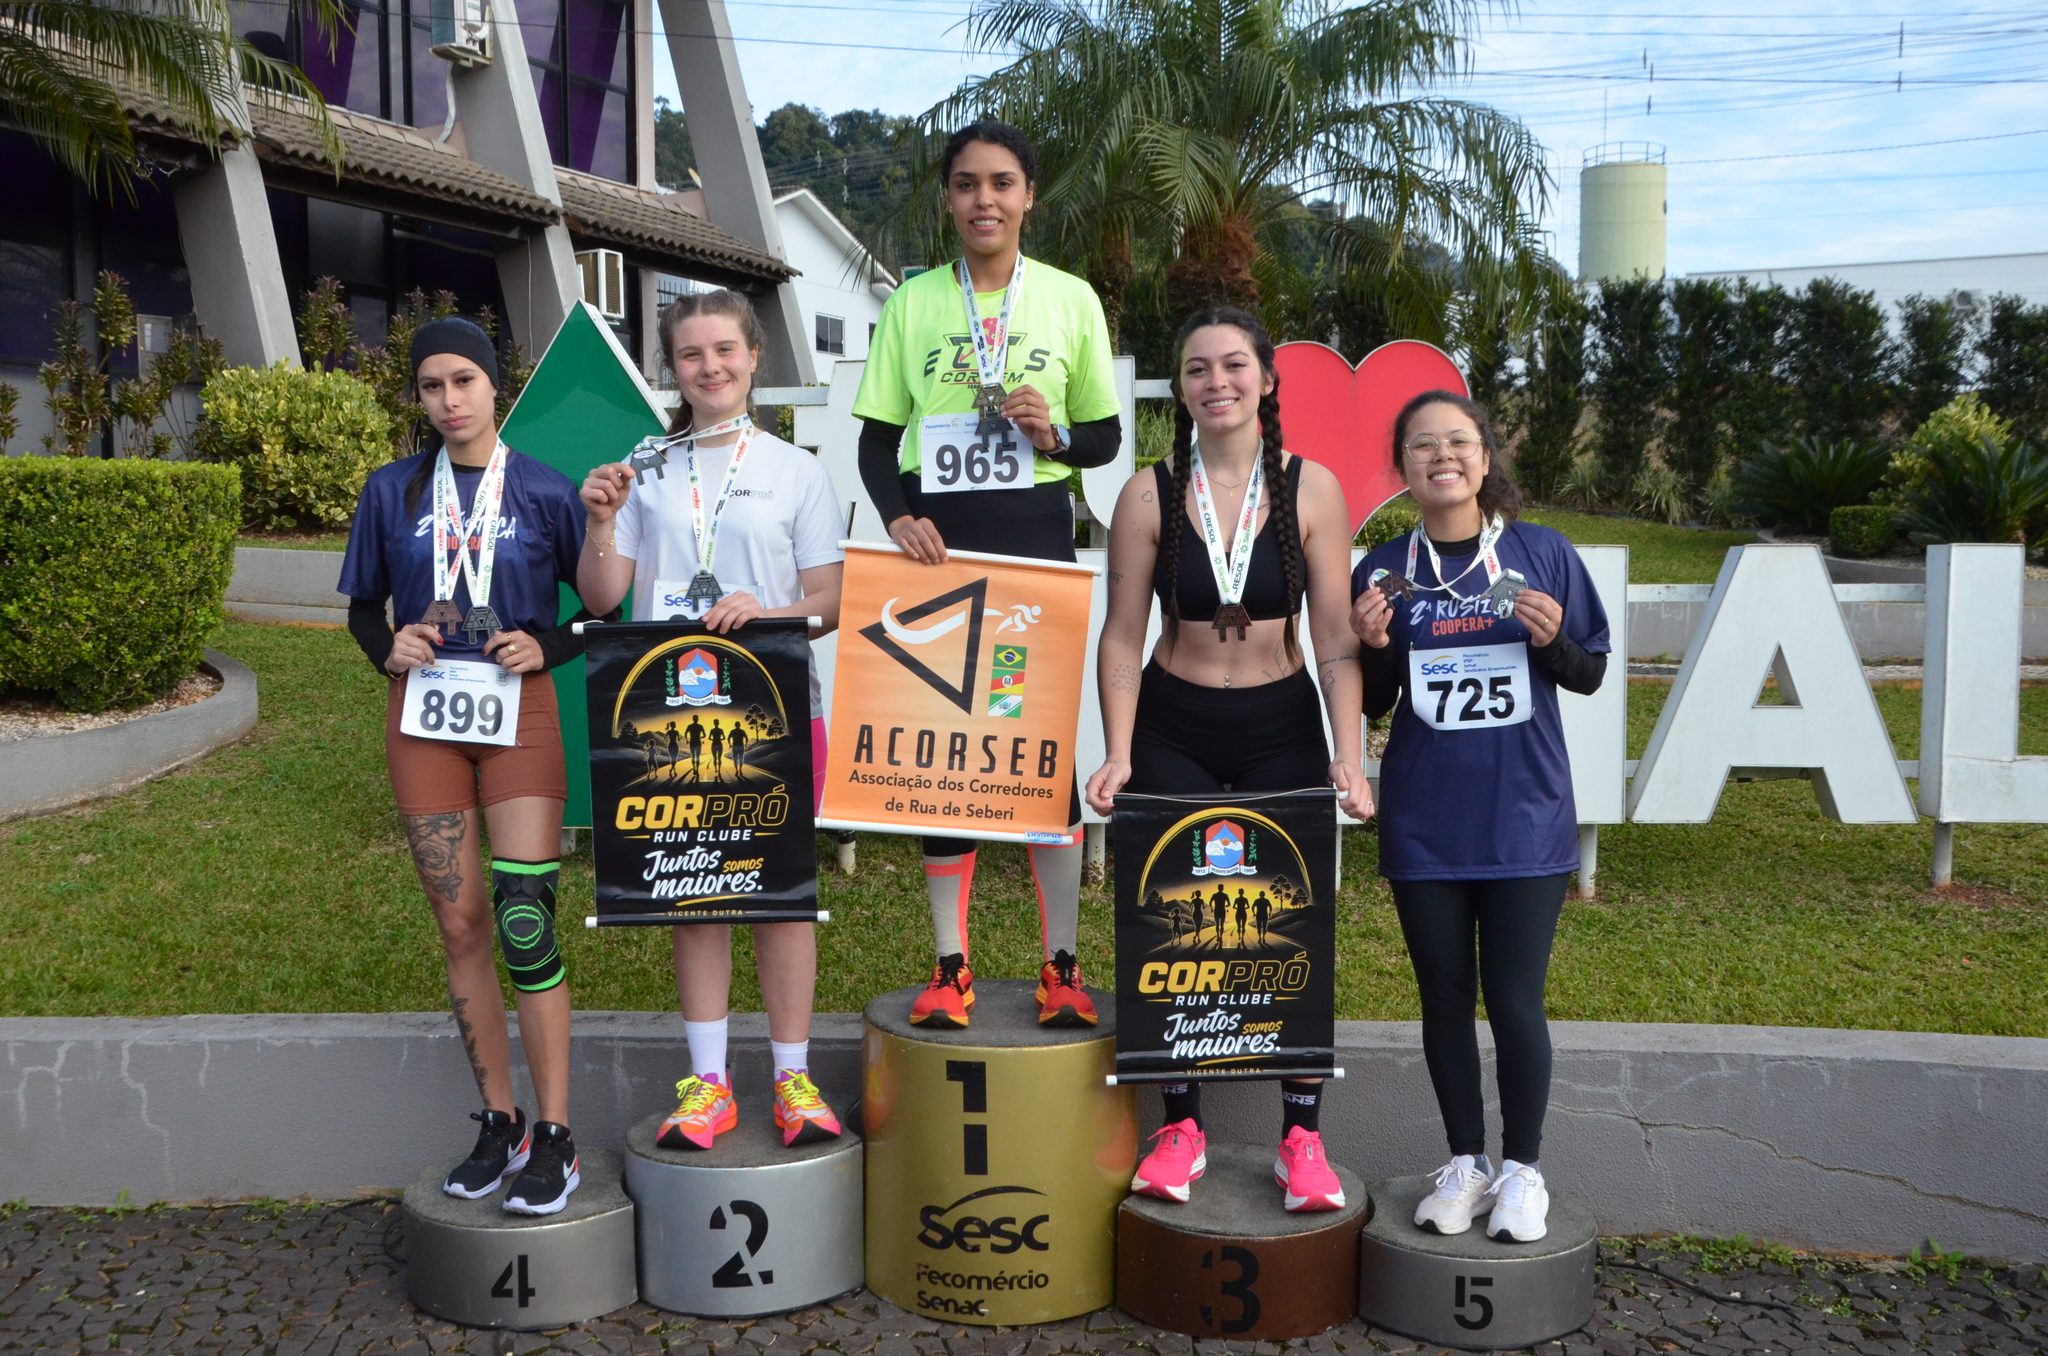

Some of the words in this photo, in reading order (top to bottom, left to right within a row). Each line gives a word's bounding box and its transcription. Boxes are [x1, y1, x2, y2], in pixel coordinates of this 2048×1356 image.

[936, 442, 1019, 485] 965
[664, 594, 693, 607] Ses
[1432, 616, 1494, 636] COOPERA+
[1421, 663, 1458, 675] Sesc
[420, 689, 503, 736] 899
[1427, 676, 1515, 723] 725
[854, 724, 1058, 778] ACORSEB
[849, 769, 932, 792] Associação
[937, 776, 964, 791] dos
[970, 779, 1053, 799] Corredores
[615, 784, 790, 830] CORPRÓ
[885, 797, 904, 812] de
[909, 799, 937, 815] Rua
[942, 801, 960, 816] de
[966, 804, 1014, 820] Seberi
[653, 831, 688, 843] RUN
[697, 829, 752, 842] CLUBE
[643, 845, 722, 881] Juntos
[723, 857, 764, 873] somos
[651, 871, 763, 899] maiores.
[712, 909, 743, 917] DUTRA
[1138, 951, 1310, 994] CORPRÓ
[1175, 995, 1209, 1006] RUN
[1218, 993, 1272, 1005] CLUBE
[1163, 1008, 1241, 1041] Juntos
[1242, 1020, 1283, 1035] somos
[1171, 1032, 1281, 1059] maiores.
[1187, 1068, 1226, 1076] VICENTE
[1231, 1067, 1261, 1075] DUTRA
[946, 1060, 988, 1175] 1
[709, 1200, 774, 1288] 2
[917, 1204, 1049, 1254] Sesc
[491, 1254, 535, 1308] 4
[1201, 1246, 1260, 1334] 3
[917, 1291, 986, 1317] Senac
[1453, 1275, 1494, 1331] 5
